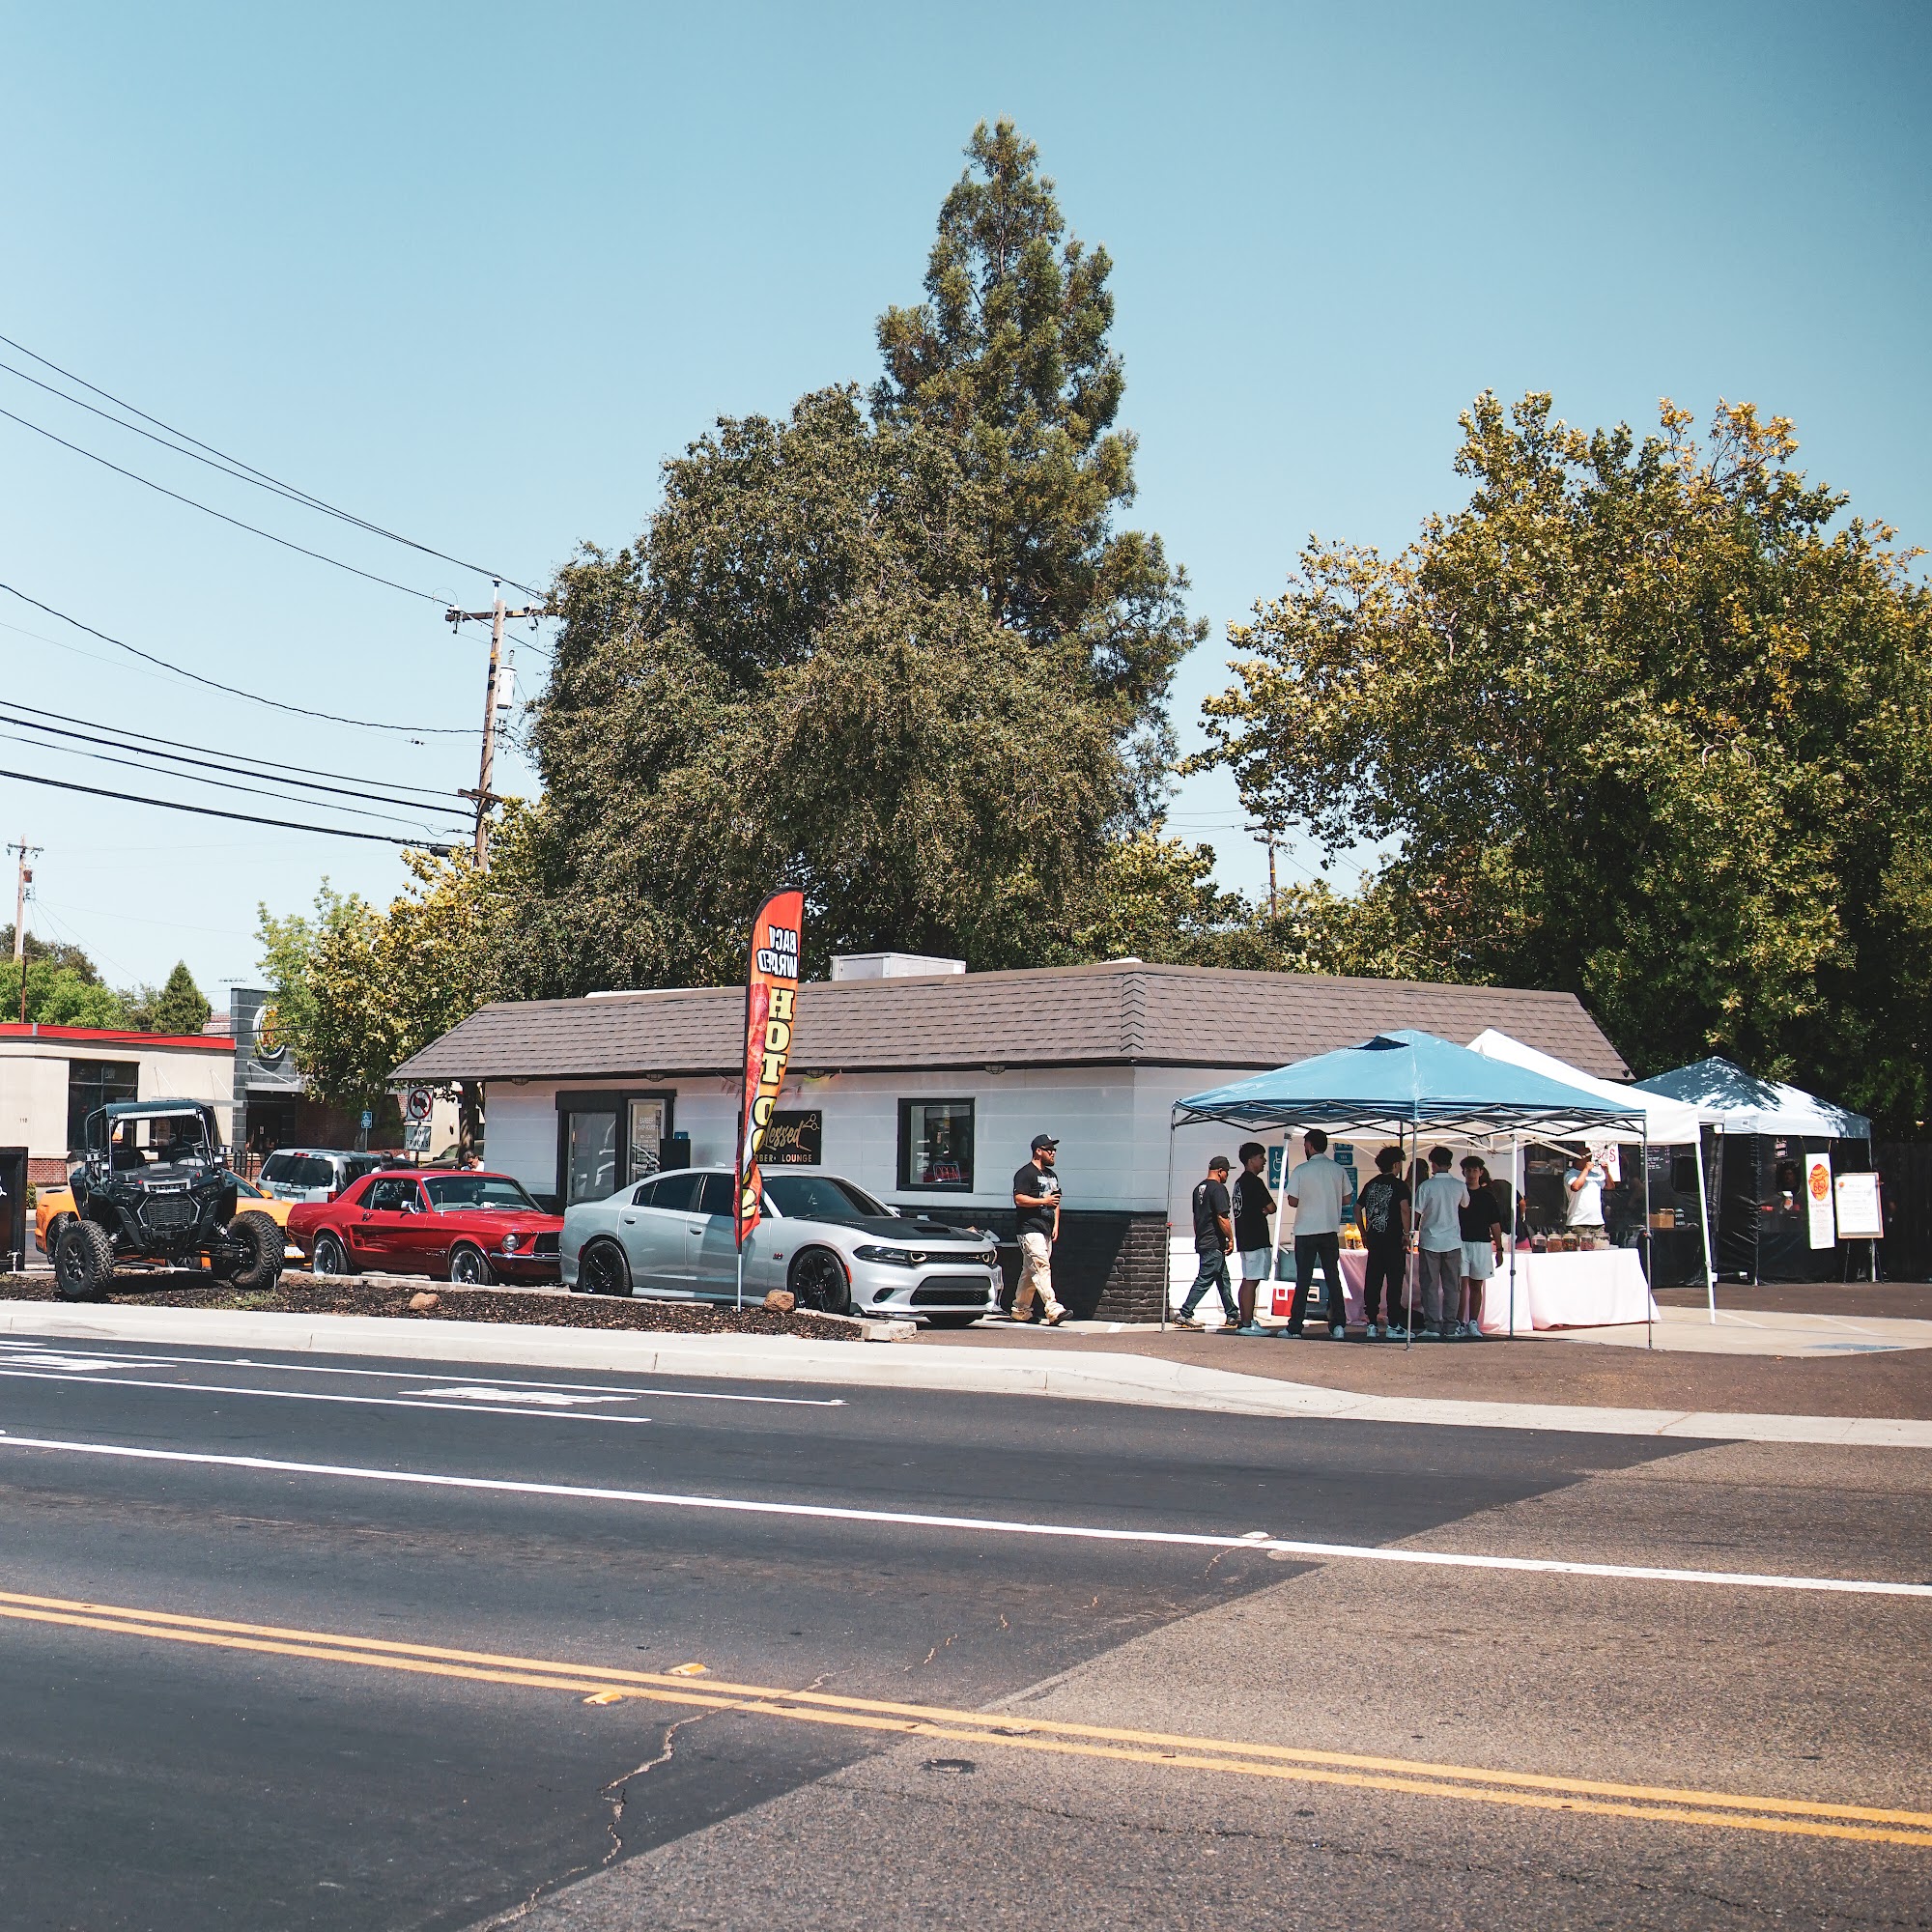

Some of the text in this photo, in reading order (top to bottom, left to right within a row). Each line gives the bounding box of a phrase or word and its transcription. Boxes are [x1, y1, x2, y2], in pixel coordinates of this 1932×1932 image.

[757, 1119, 811, 1152] lessed
[754, 1153, 812, 1163] RBER LOUNGE
